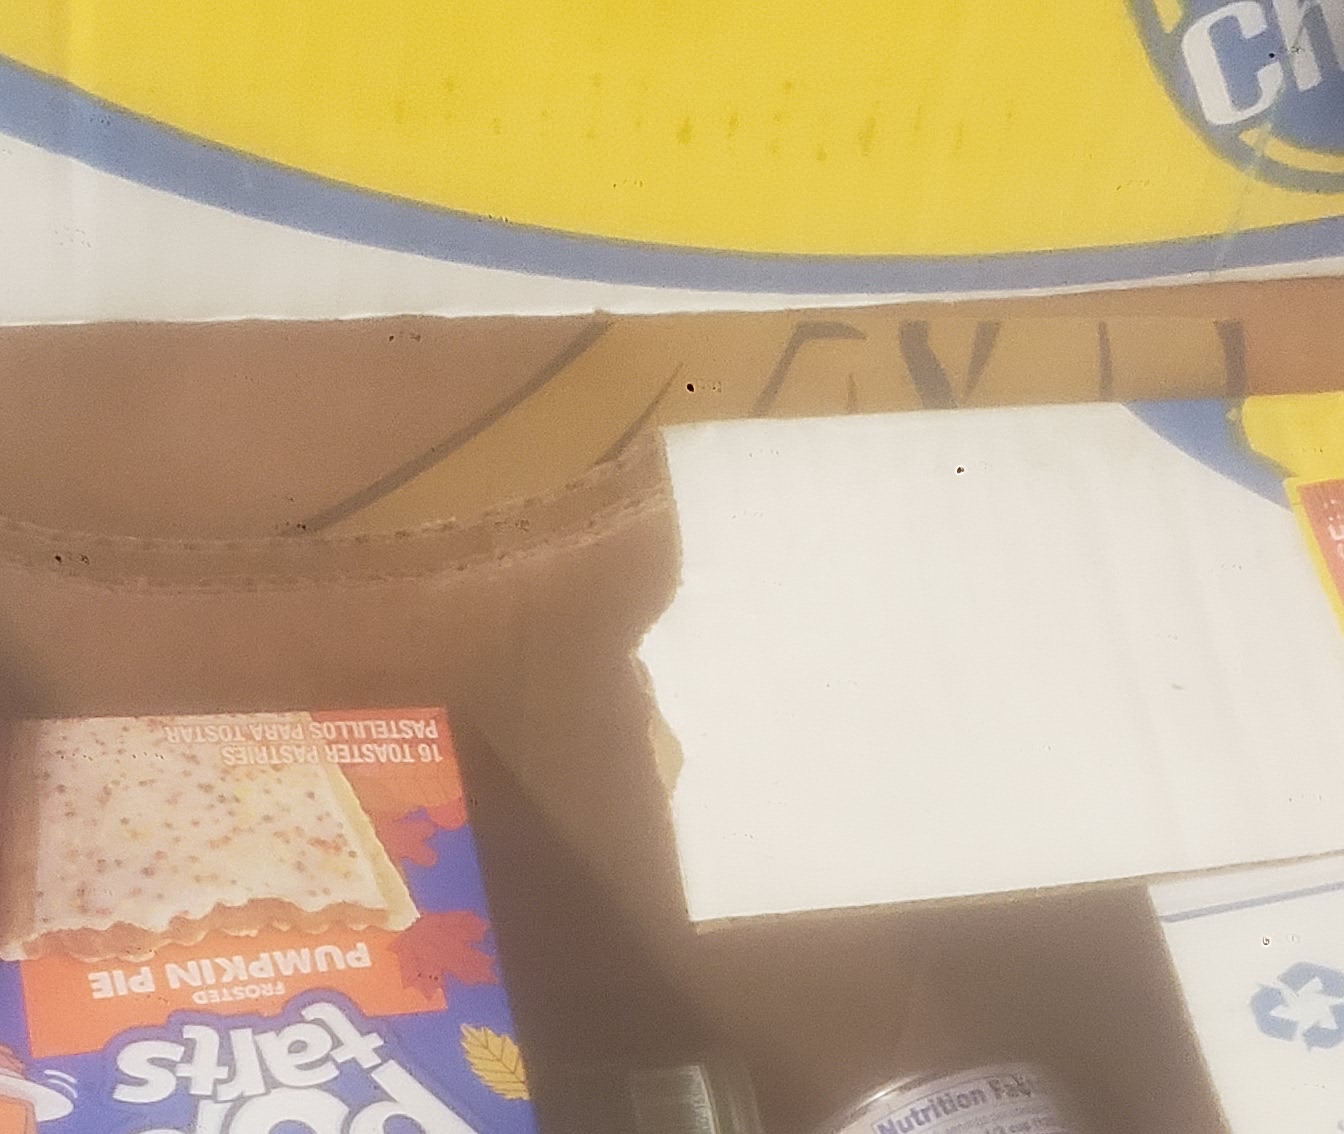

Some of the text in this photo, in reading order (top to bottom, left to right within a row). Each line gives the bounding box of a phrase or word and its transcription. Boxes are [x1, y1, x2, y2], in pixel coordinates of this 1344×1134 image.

[165, 720, 438, 744] PASTELILLOS PARA TOSTAR
[223, 744, 443, 766] 16 TOASTER PASTRIES
[89, 941, 372, 999] PUMPKIN PIE
[193, 981, 286, 1006] FROSTED
[112, 1001, 386, 1104] tarts
